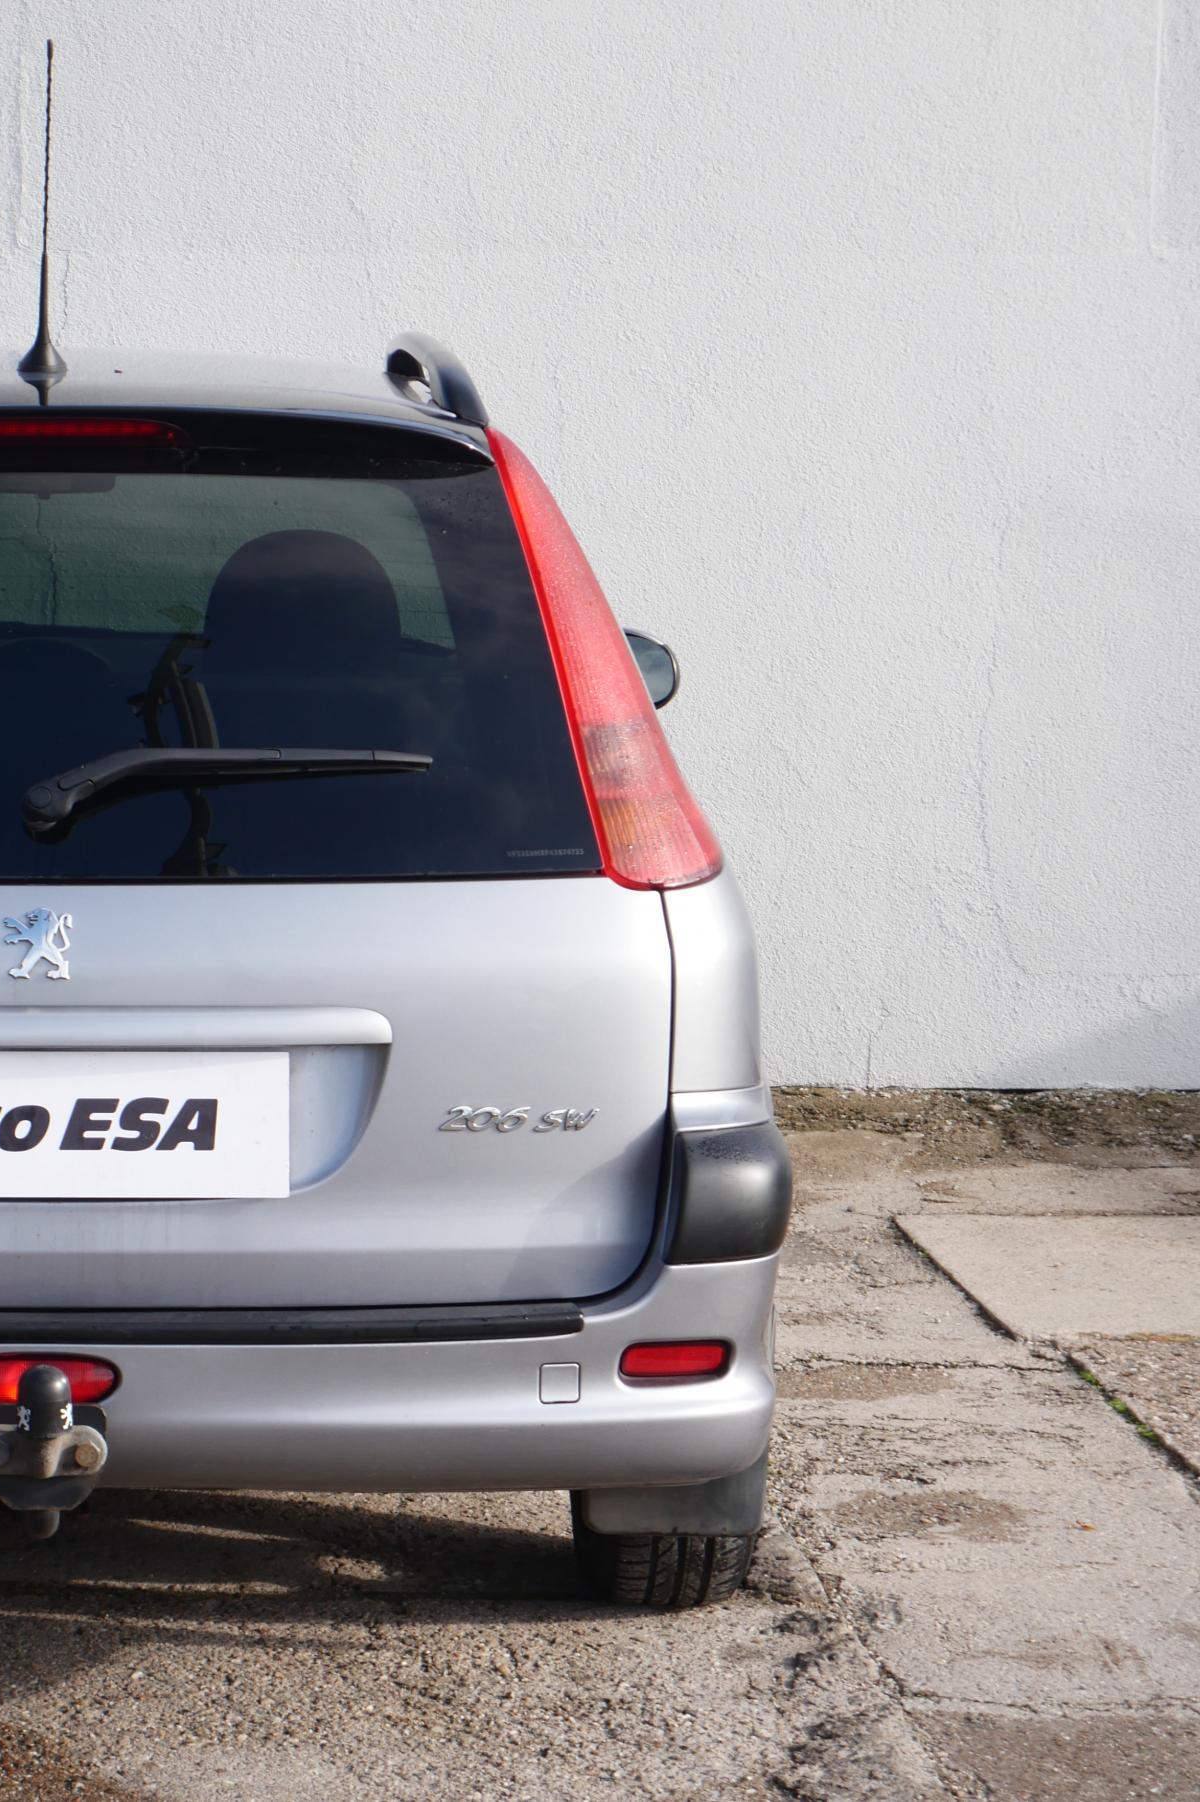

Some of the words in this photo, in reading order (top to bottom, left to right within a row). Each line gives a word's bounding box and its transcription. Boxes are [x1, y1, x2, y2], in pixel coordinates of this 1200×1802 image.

[59, 1097, 218, 1151] ESA
[438, 1105, 531, 1132] 206
[533, 1108, 600, 1132] SW
